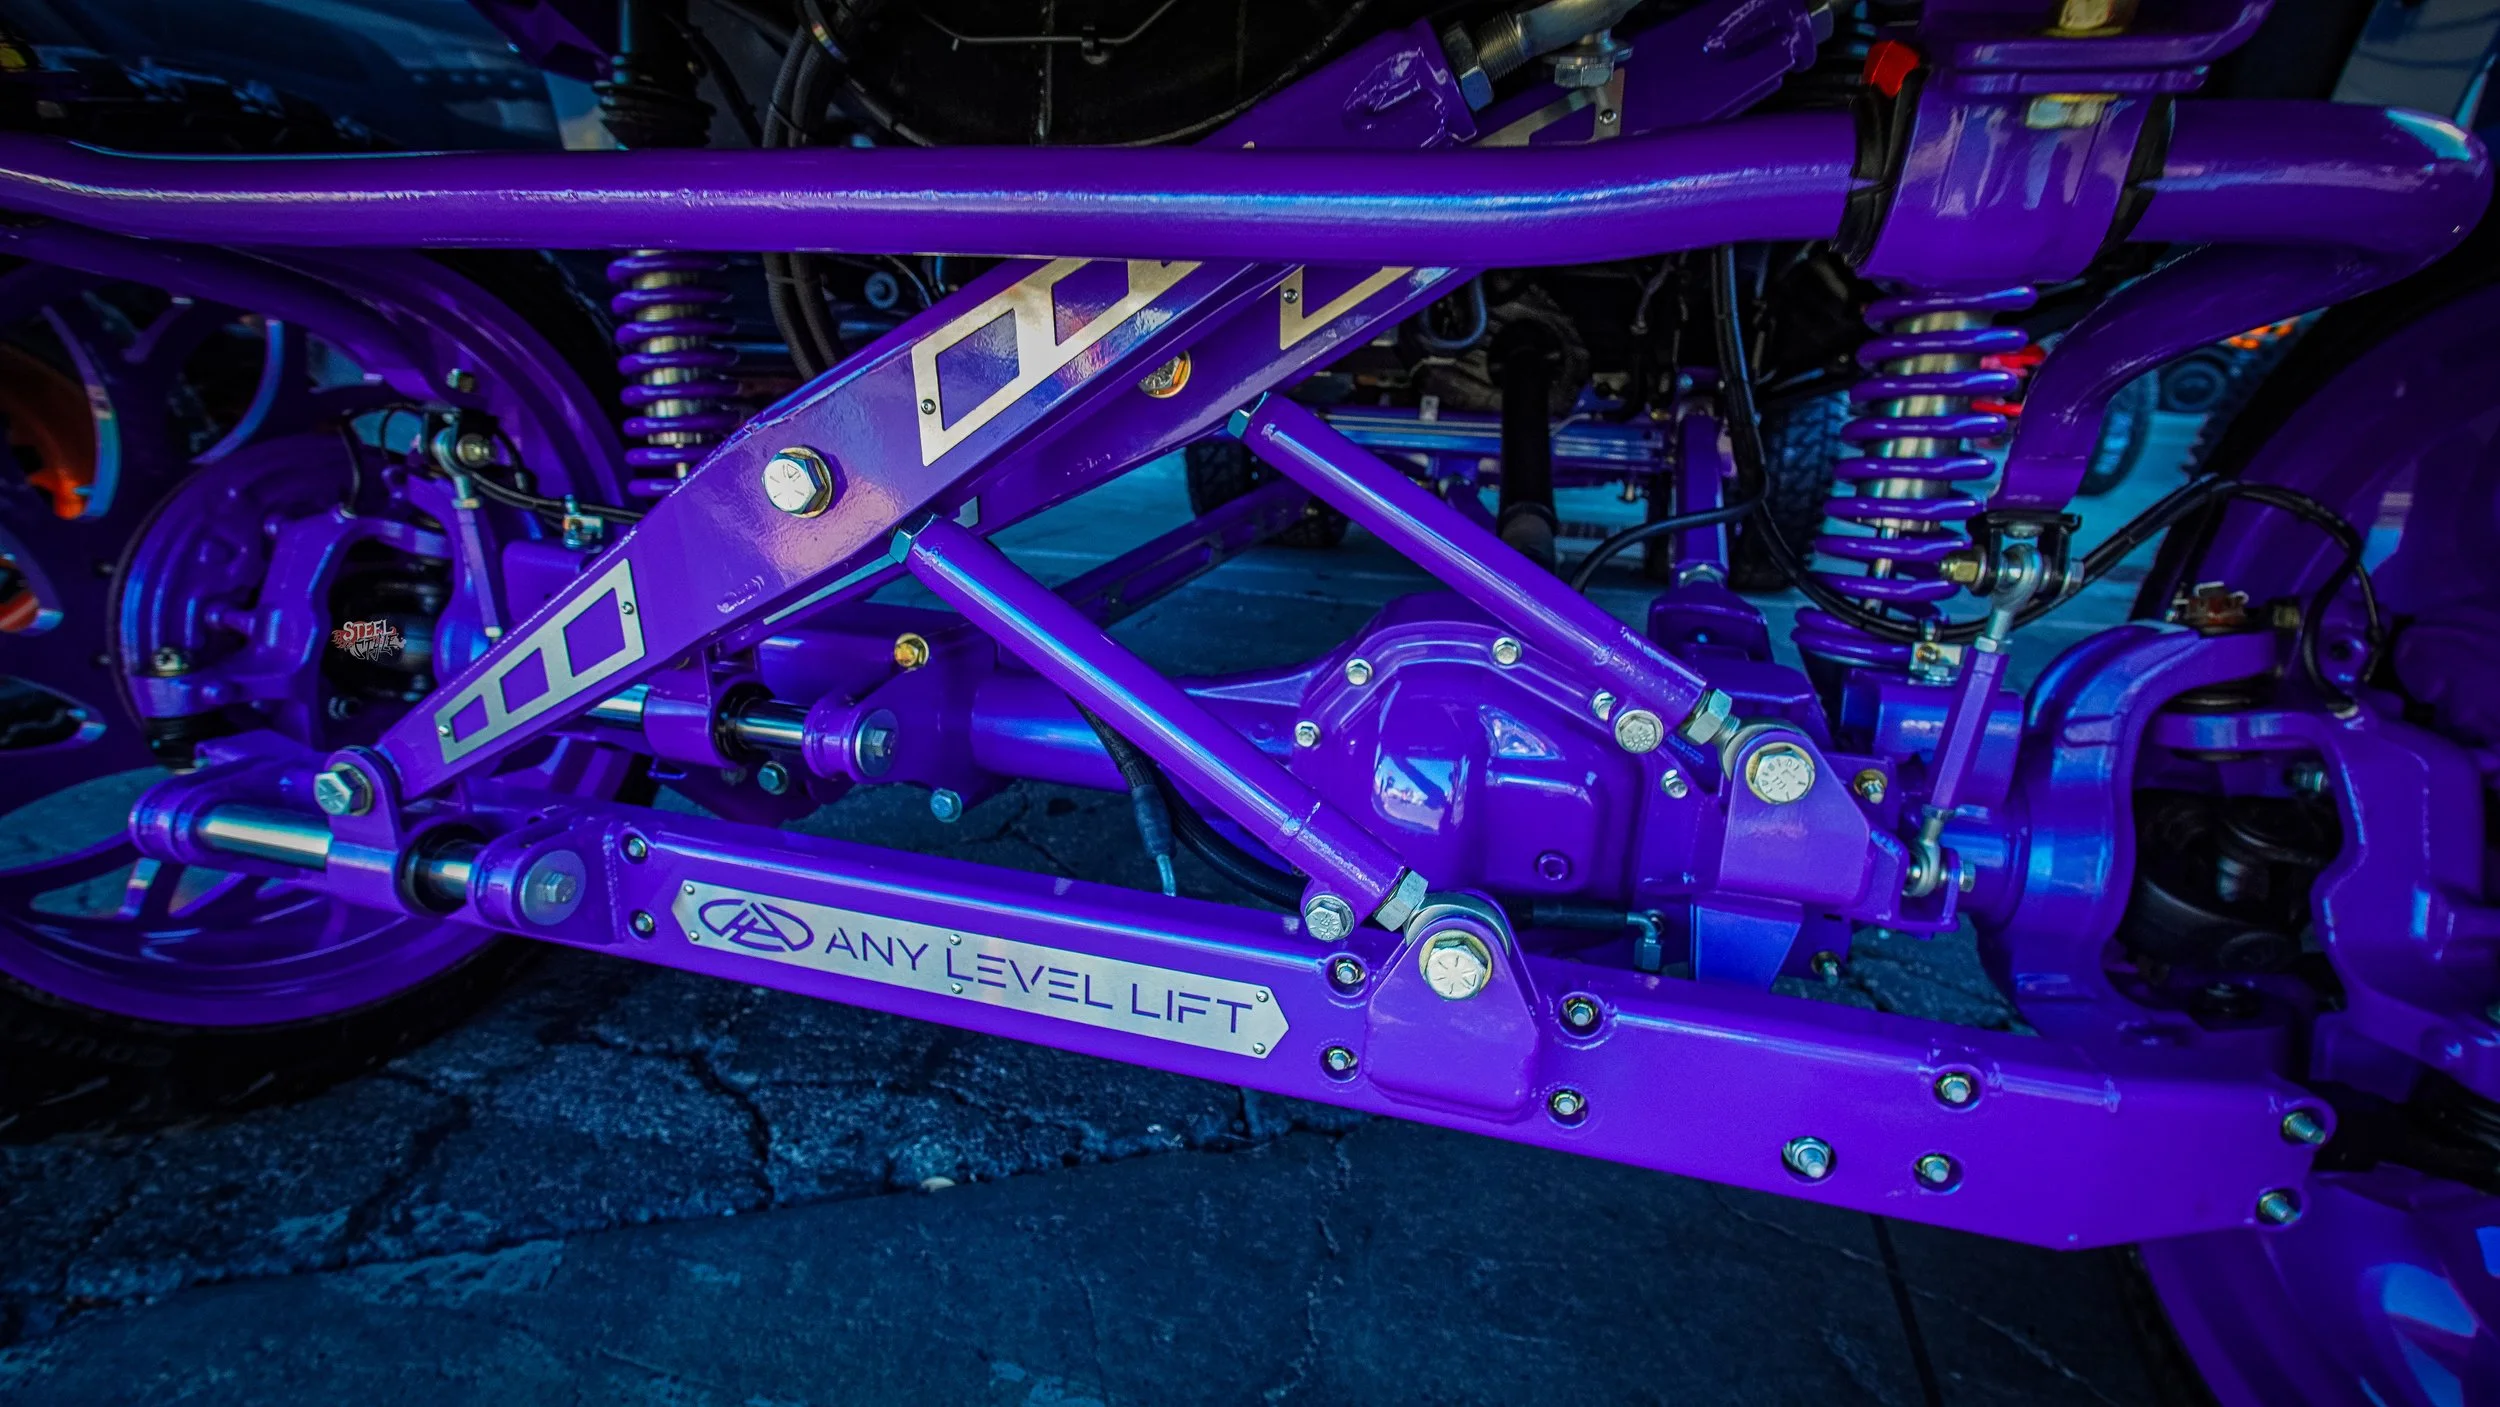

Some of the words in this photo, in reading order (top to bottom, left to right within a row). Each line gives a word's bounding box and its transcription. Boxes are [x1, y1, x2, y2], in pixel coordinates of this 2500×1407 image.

[825, 927, 929, 971] ANY
[947, 948, 1113, 1010] LEVEL
[1132, 983, 1253, 1034] LIFT
